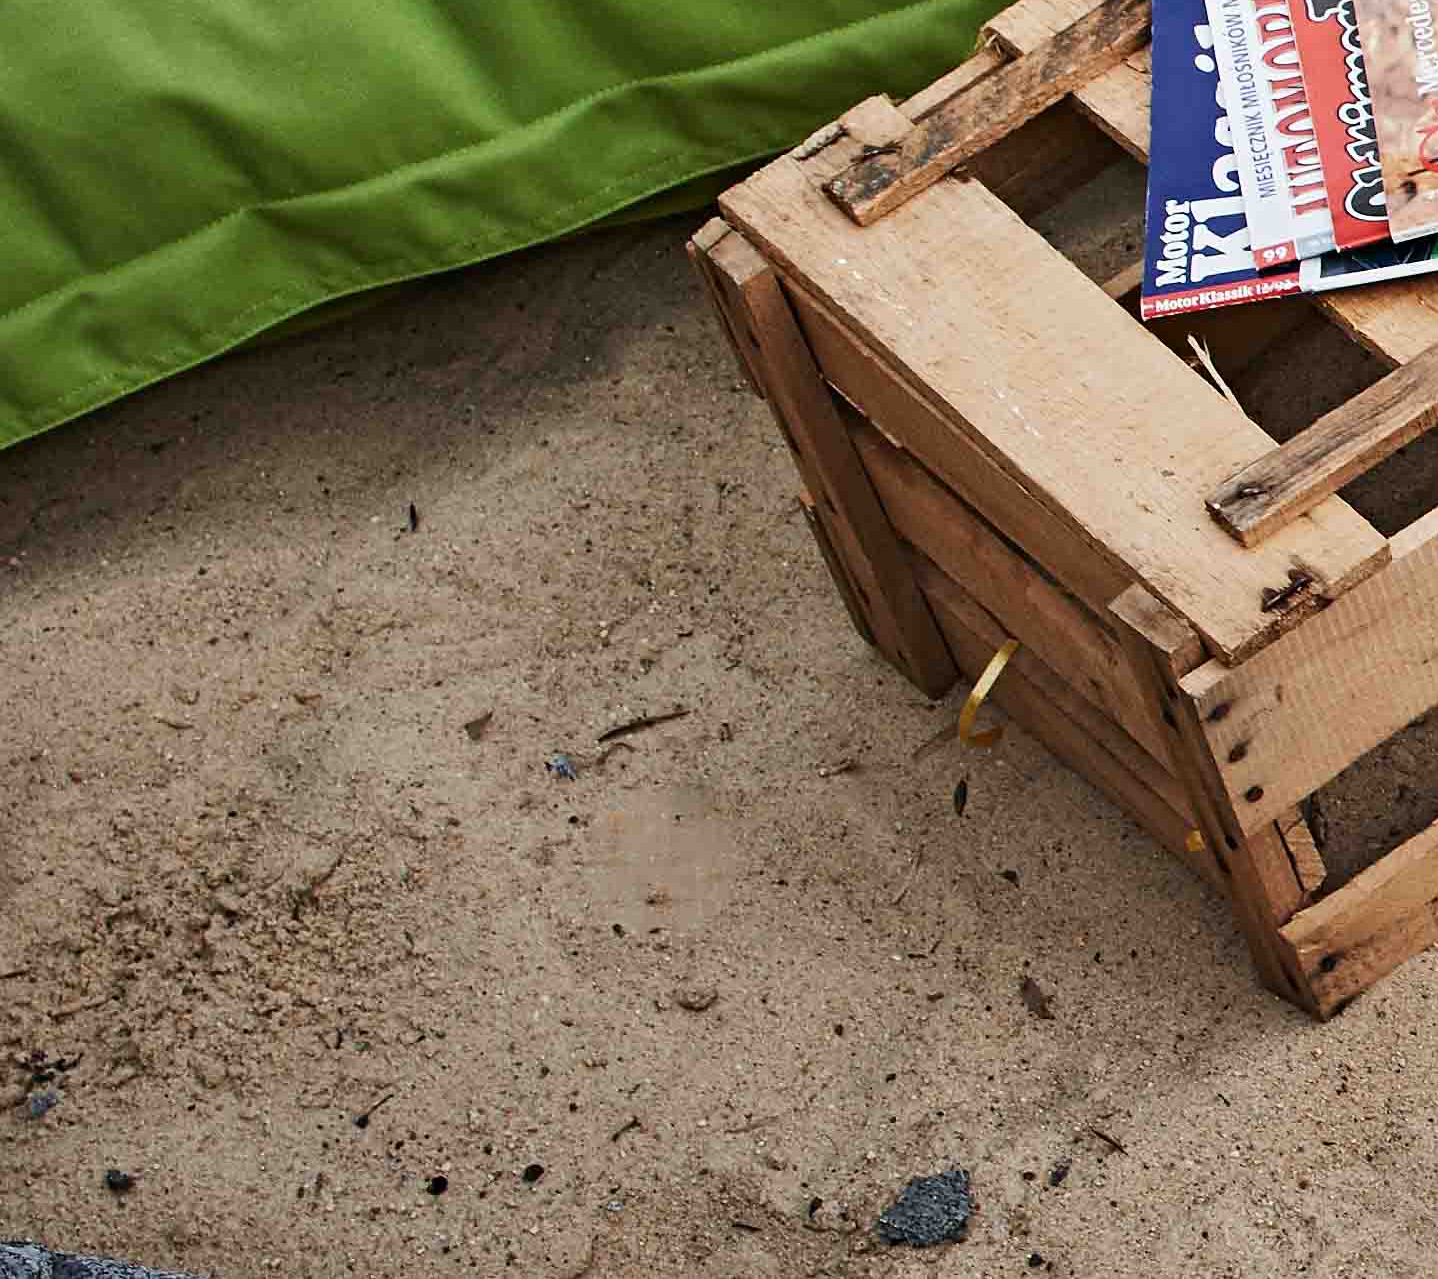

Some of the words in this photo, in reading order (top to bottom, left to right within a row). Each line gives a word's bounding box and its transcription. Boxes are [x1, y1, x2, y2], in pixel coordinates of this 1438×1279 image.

[1221, 12, 1259, 108] MIŁOŚNIKÓW
[1239, 111, 1277, 198] MIESIĘCZNIK
[1155, 199, 1189, 286] Motor
[1198, 284, 1253, 304] Klassik
